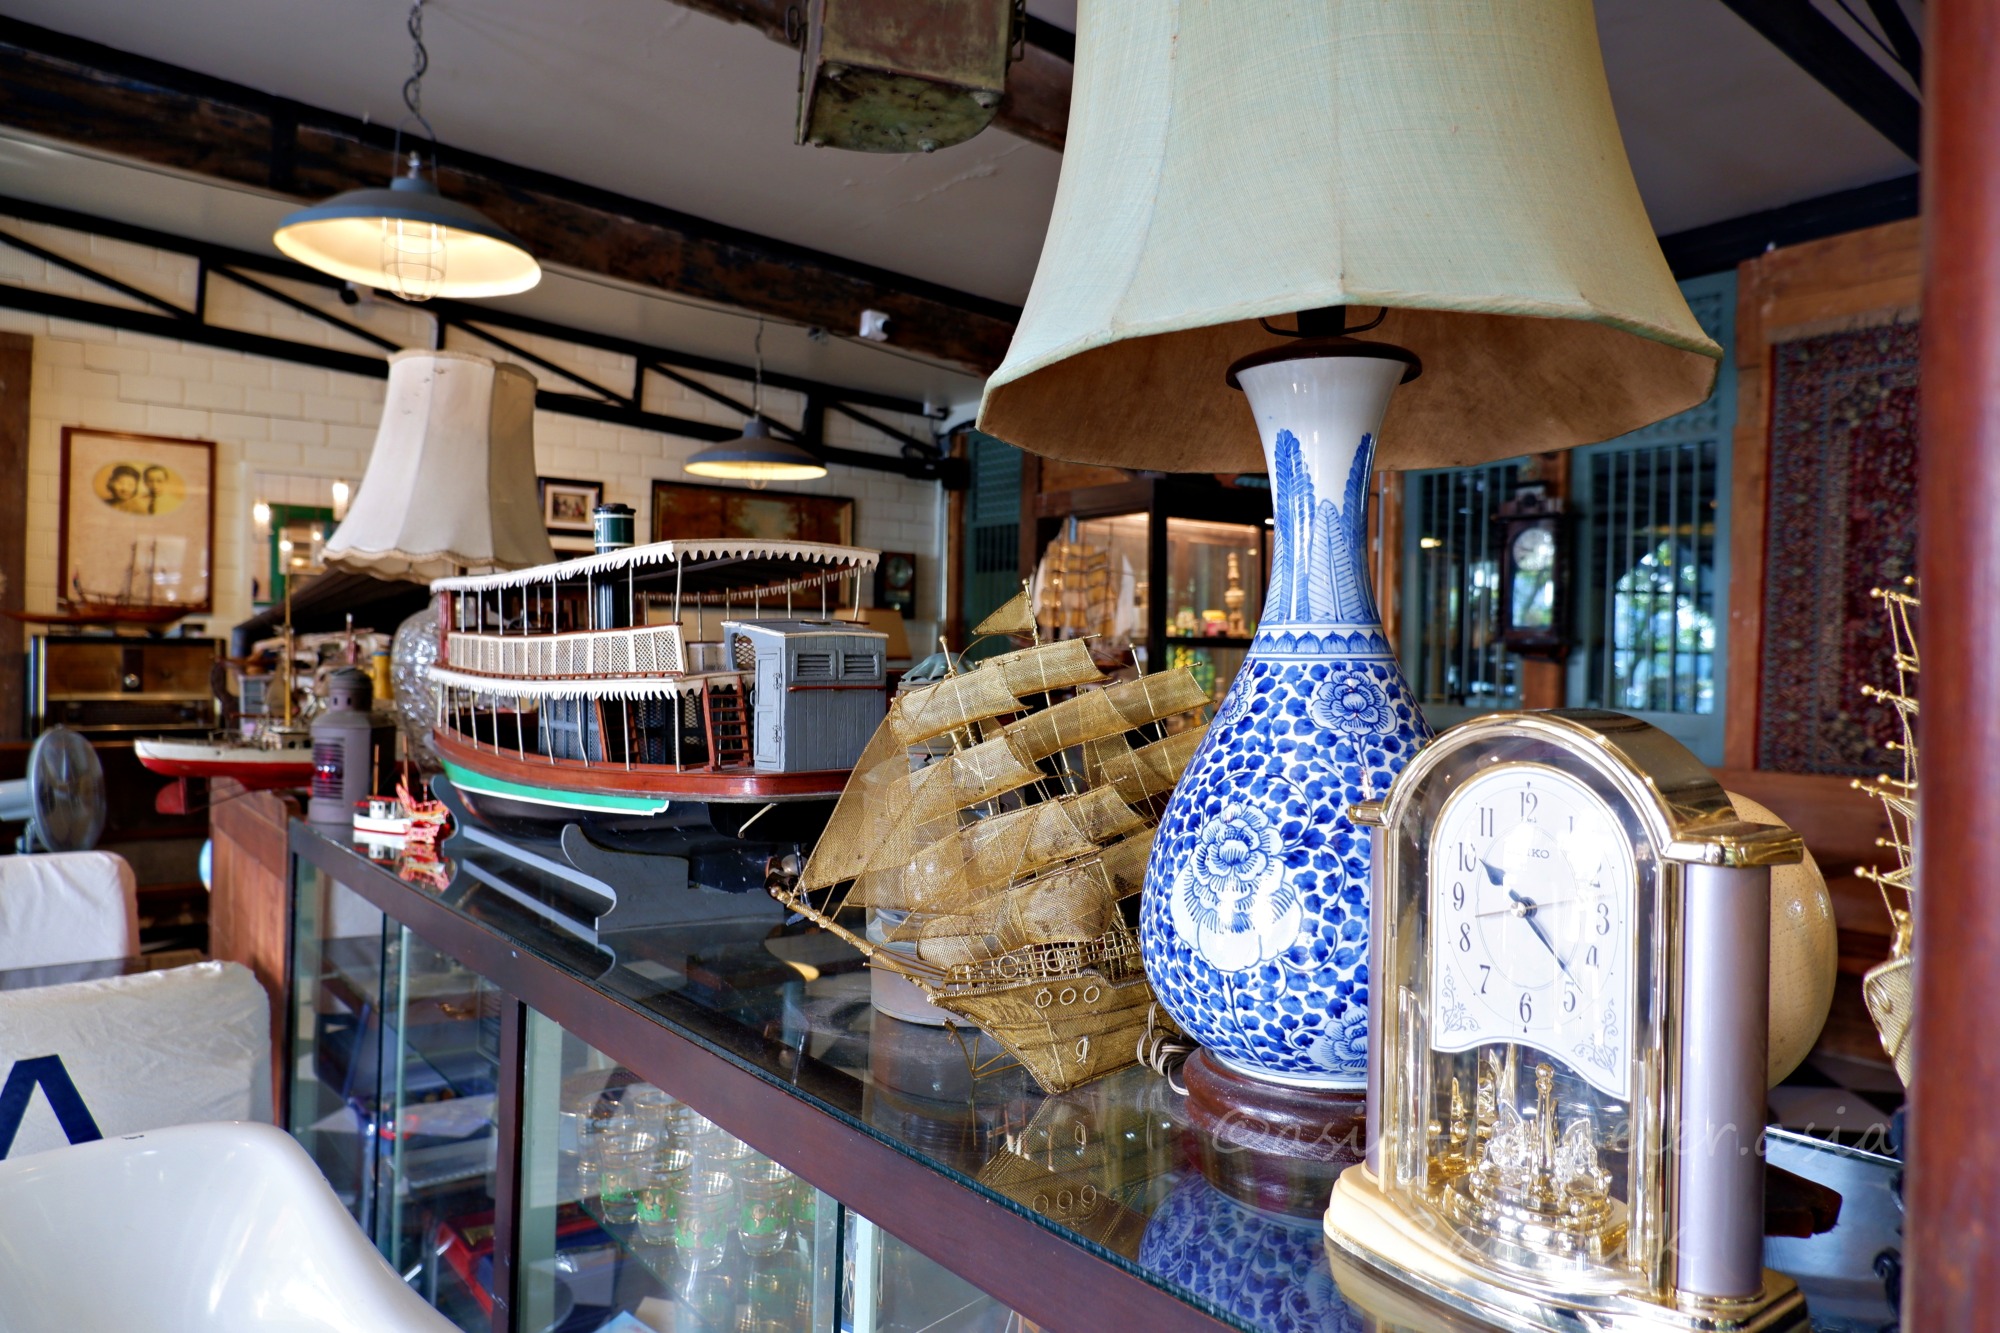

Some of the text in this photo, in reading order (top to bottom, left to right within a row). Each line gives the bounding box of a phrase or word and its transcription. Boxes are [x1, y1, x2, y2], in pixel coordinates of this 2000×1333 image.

[1480, 807, 1493, 837] 11
[1520, 792, 1538, 823] 12
[1458, 842, 1477, 873] 10
[1453, 881, 1465, 911] 9
[1596, 903, 1610, 936] 3
[1459, 922, 1471, 952] 8
[1479, 964, 1491, 994] 7
[1519, 992, 1532, 1023] 6
[1563, 981, 1576, 1013] 5
